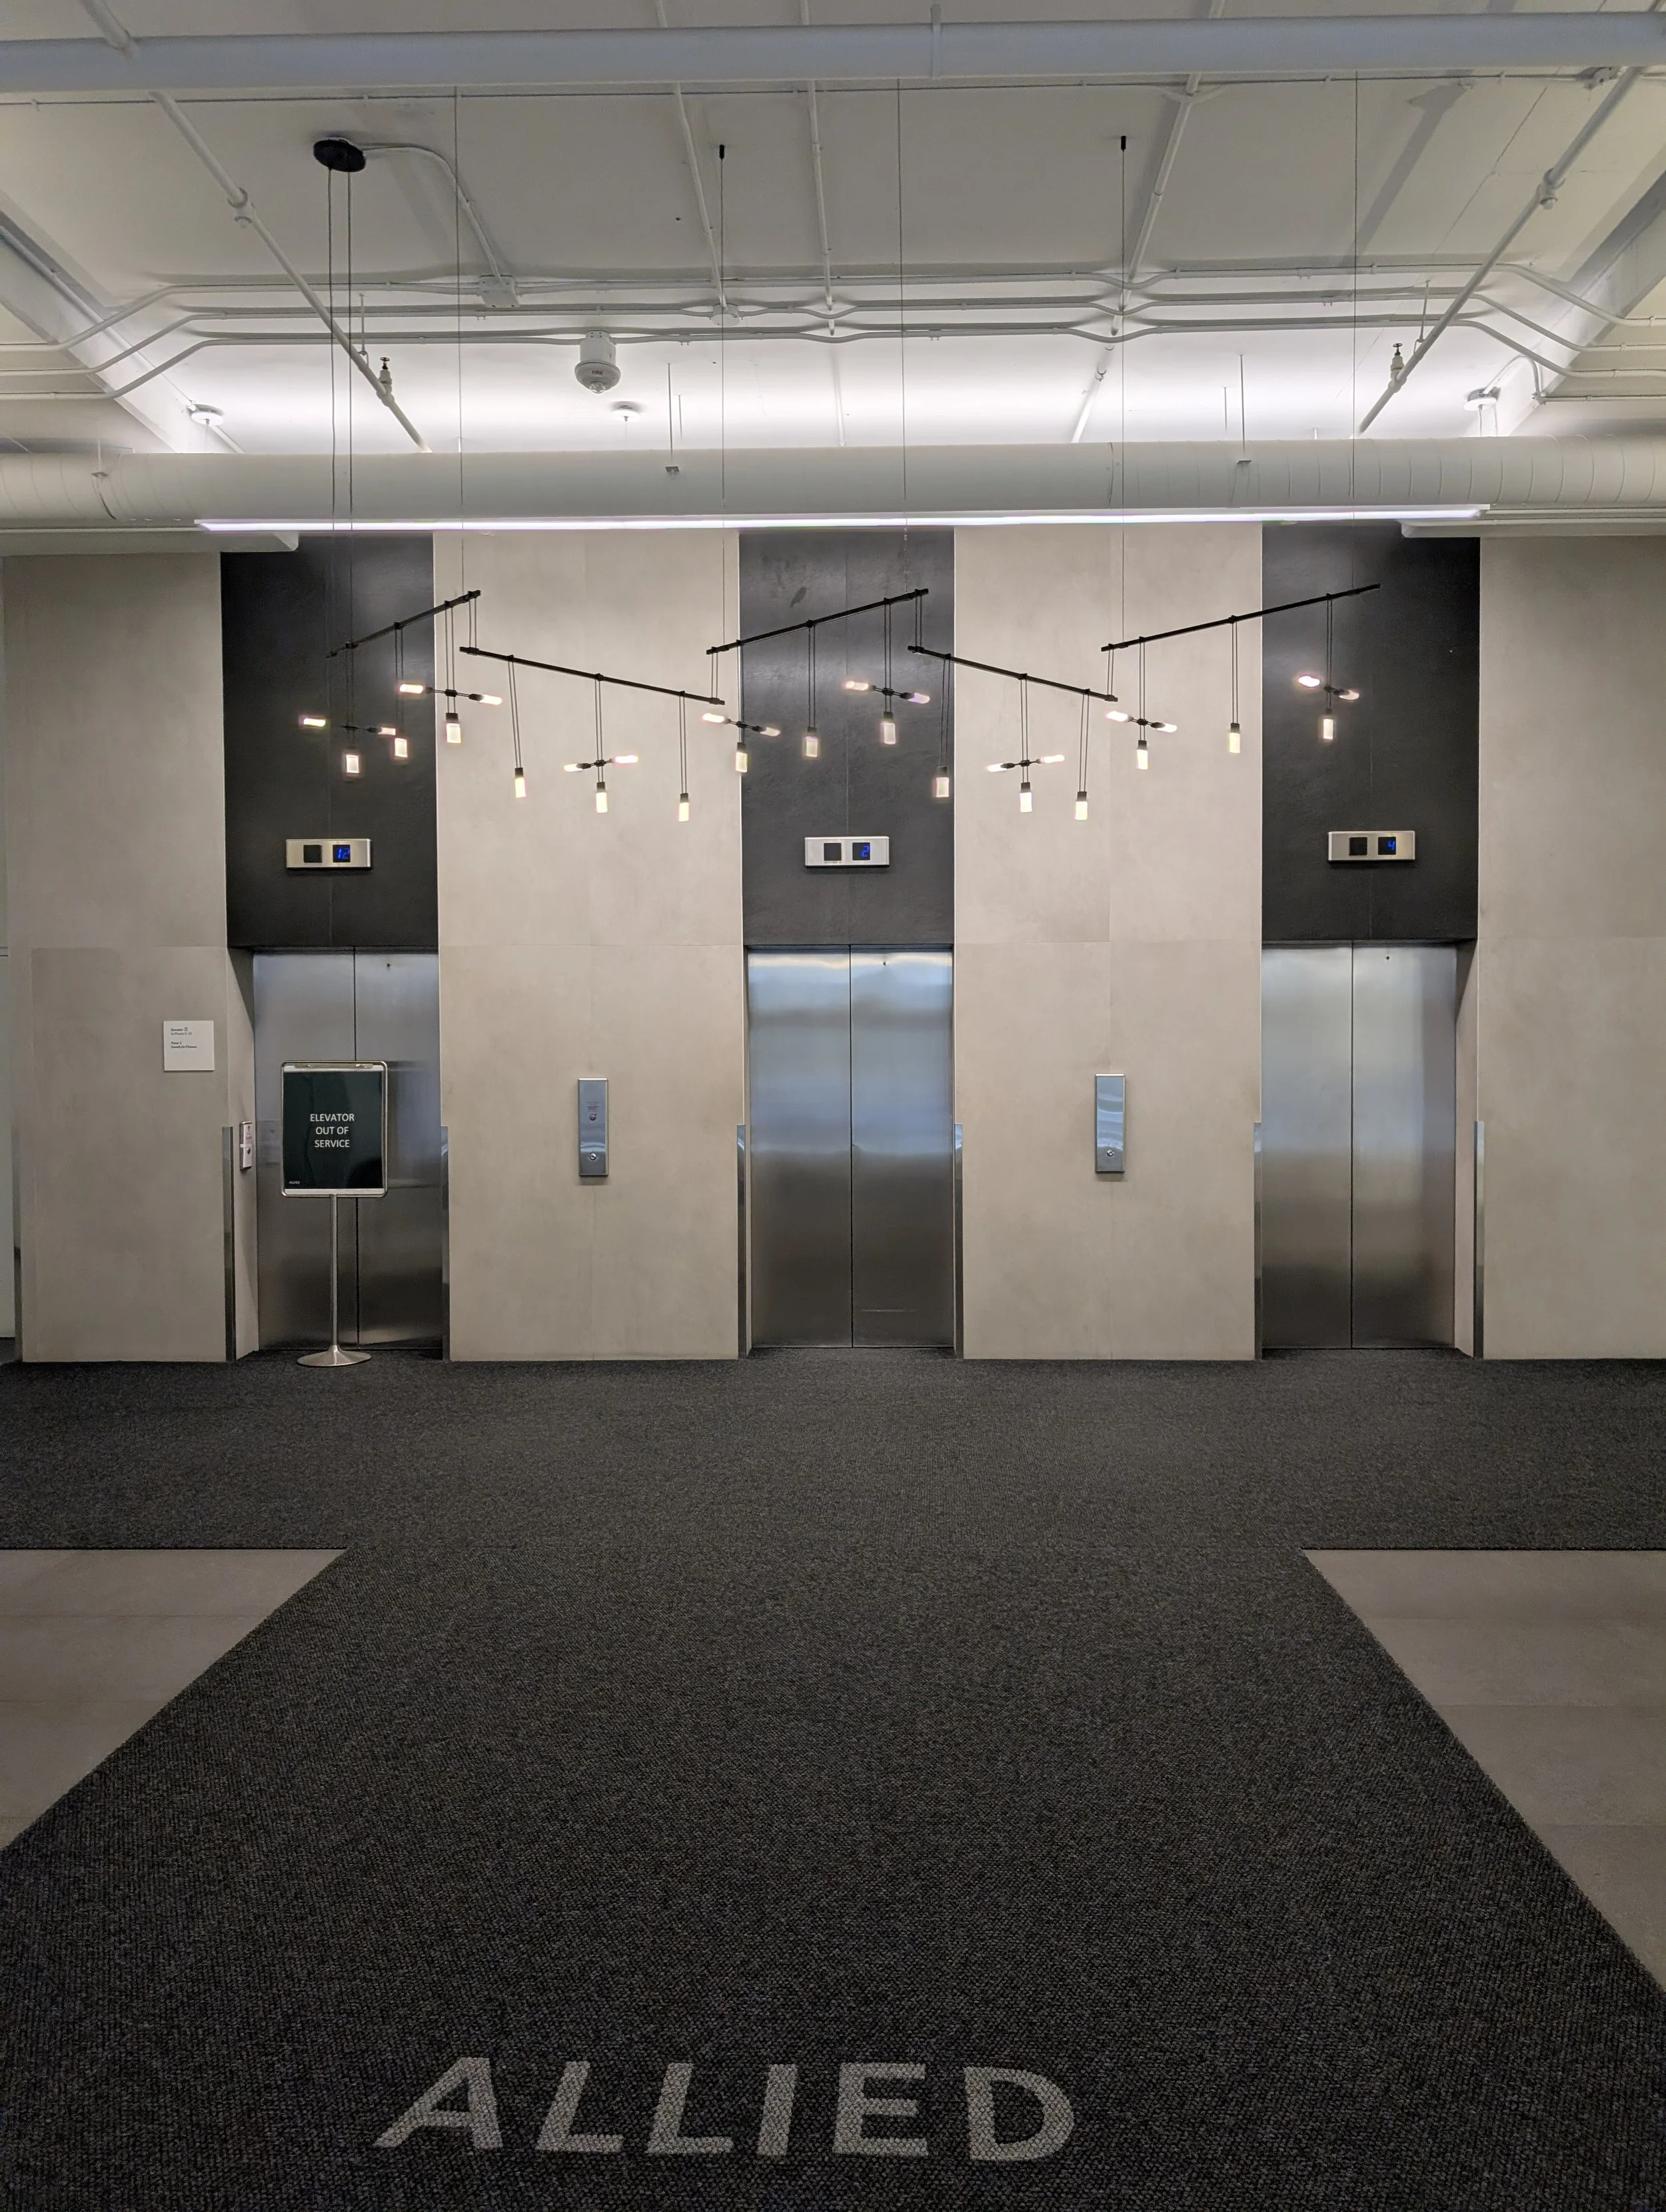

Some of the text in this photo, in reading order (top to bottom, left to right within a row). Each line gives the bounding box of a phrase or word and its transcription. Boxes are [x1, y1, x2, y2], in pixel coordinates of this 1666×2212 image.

[862, 845, 870, 857] 2
[310, 1113, 355, 1122] ELEVATOR
[315, 1126, 349, 1135] OUT OF
[314, 1139, 350, 1148] SERVICE
[372, 2055, 1075, 2163] ALLIED
